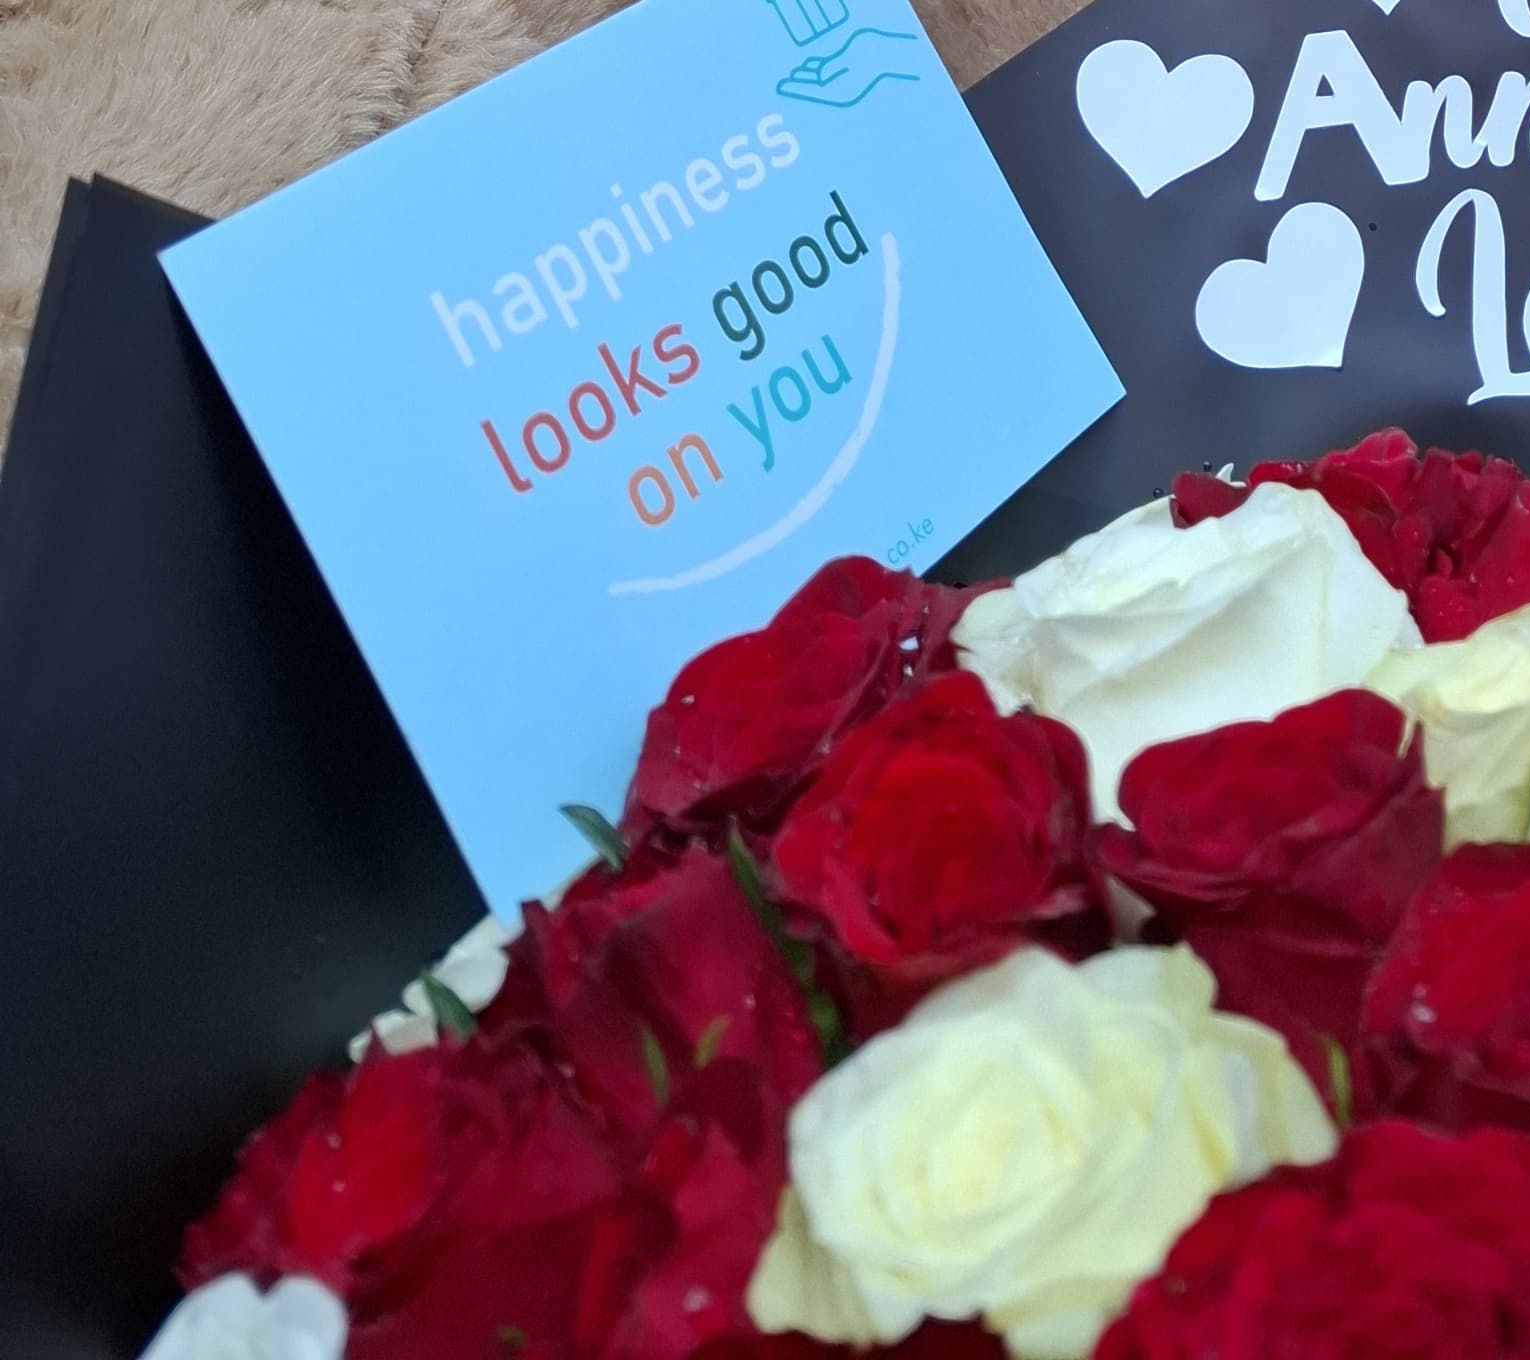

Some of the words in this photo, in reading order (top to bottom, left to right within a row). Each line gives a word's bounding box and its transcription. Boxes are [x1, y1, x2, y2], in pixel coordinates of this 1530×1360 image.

[429, 111, 801, 368] happiness
[480, 323, 700, 494] looks
[711, 190, 869, 361] good
[627, 432, 723, 527] on
[725, 334, 854, 471] you
